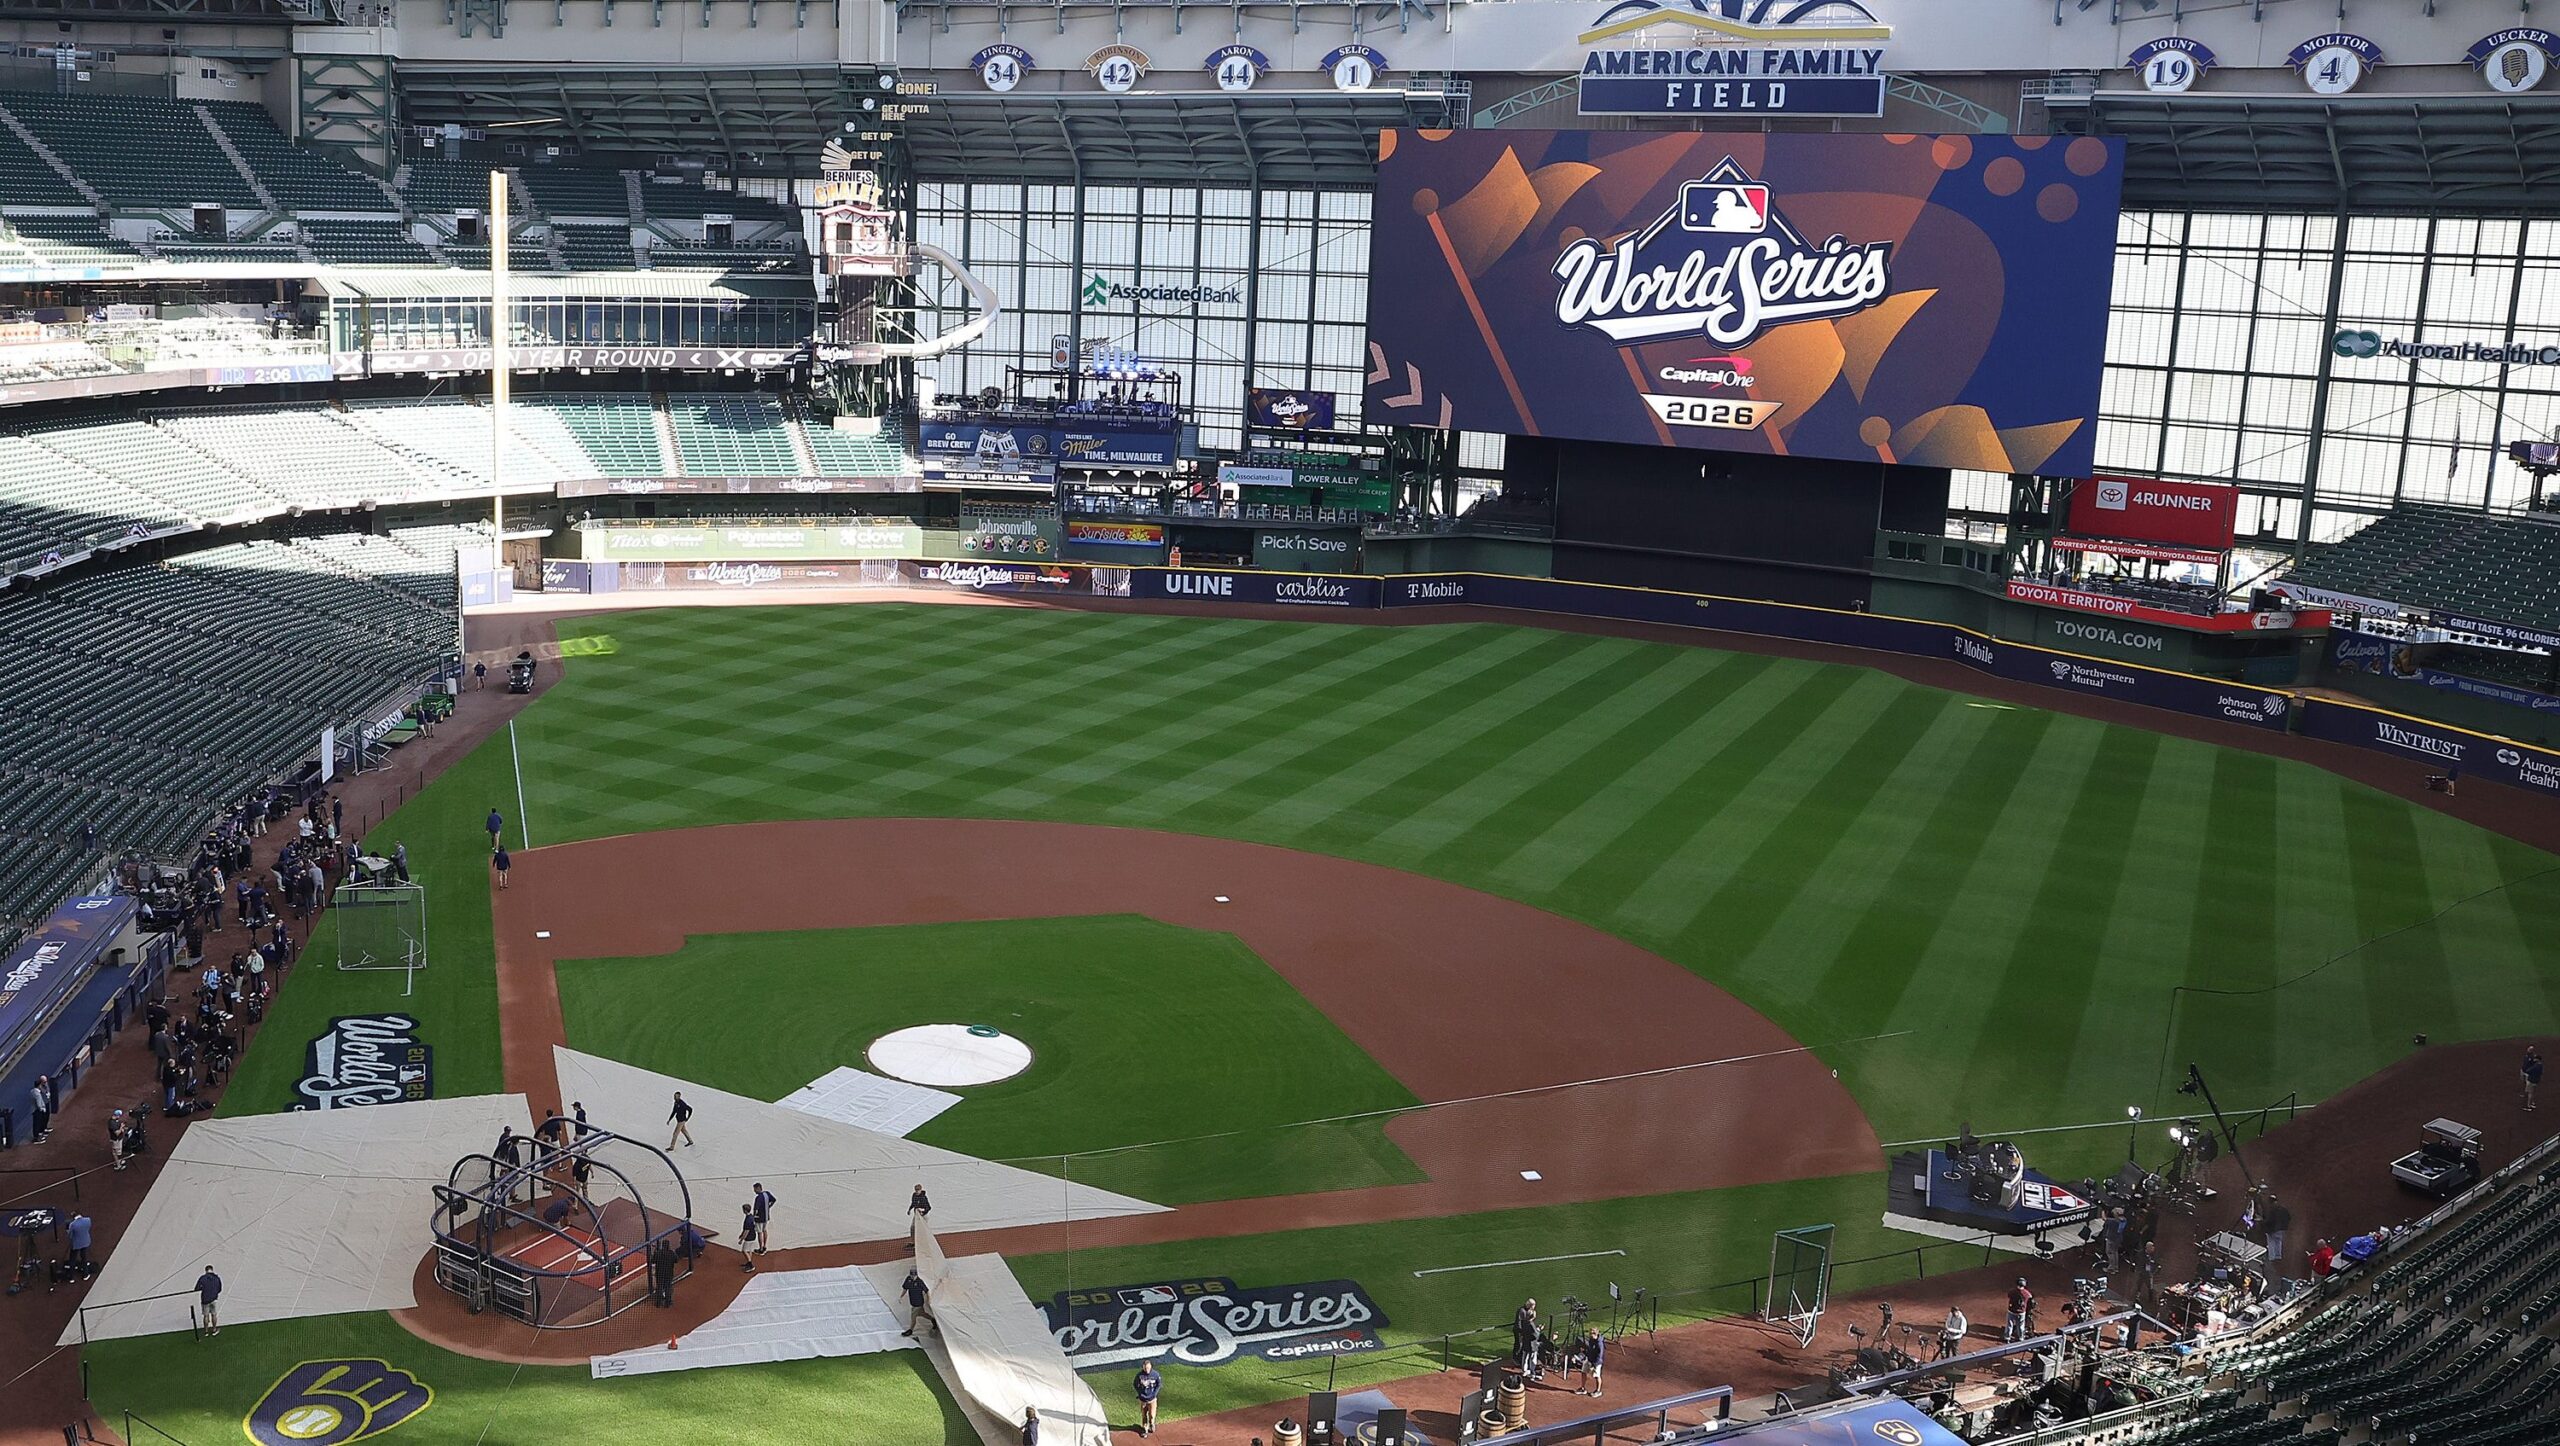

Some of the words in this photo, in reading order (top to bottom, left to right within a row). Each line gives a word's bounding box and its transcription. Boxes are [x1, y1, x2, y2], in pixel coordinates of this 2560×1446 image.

[2150, 40, 2197, 52] YOUNT
[2303, 36, 2369, 53] MOLITOR
[2488, 30, 2549, 46] UECKER
[982, 46, 1024, 59] FINGERS
[1095, 46, 1141, 61] ROBINSON
[1221, 47, 1254, 58] AARON
[1339, 46, 1370, 56] SELIG
[1582, 50, 1749, 75] AMERICAN
[1762, 49, 1885, 76] FAMILY
[2318, 58, 2342, 84] 4
[988, 62, 1016, 84] 34
[1103, 64, 1132, 84] 42
[1222, 64, 1251, 85] 44
[1348, 65, 1360, 86] 1
[2152, 60, 2190, 86] 19
[896, 84, 938, 95] GONE!
[1666, 83, 1786, 109] FIELD
[882, 105, 899, 113] GET
[900, 105, 930, 113] OUTTA
[882, 113, 906, 121] HERE
[861, 132, 878, 141] GET
[880, 132, 893, 141] UP
[851, 152, 868, 160] GET
[870, 152, 883, 160] UP
[826, 171, 873, 183] BERNIE'S
[815, 182, 884, 207] CHALET
[1556, 240, 1742, 325] World
[1706, 238, 1887, 344] Series
[462, 350, 519, 368] OPN
[528, 350, 582, 367] YEAR
[595, 350, 677, 367] ROUND
[717, 350, 745, 369] X
[750, 352, 810, 366] GOLF
[2386, 338, 2450, 361] Aurora
[2462, 341, 2532, 365] Health
[1666, 402, 1755, 426] 2026
[927, 440, 949, 448] BREW
[945, 432, 956, 441] GO
[1060, 439, 1108, 458] Miller
[1084, 451, 1109, 461] TIME,
[1110, 452, 1163, 463] MILWAUKEE
[945, 472, 965, 480] GREAT
[1299, 475, 1330, 484] POWER
[1332, 476, 1360, 485] ALLEY
[2132, 492, 2212, 511] 4RUNNER
[857, 529, 905, 543] clover
[975, 518, 1038, 536] Johnsonville
[1078, 526, 1126, 541] Surfside
[1309, 538, 1347, 552] Save
[2053, 540, 2088, 550] COURTESY
[2098, 545, 2117, 553] YOUR
[2118, 547, 2158, 557] WISCONSIN
[2158, 551, 2186, 559] TOYOTA
[2186, 554, 2218, 563] DEALERS
[1166, 574, 1233, 596] ULINE
[1276, 577, 1351, 597] carbliss
[1421, 582, 1464, 598] Mobile
[2010, 584, 2058, 602] TOYOTA
[2061, 593, 2133, 614] TERRITORY
[2056, 620, 2163, 651] TOYOTA.COM
[2450, 618, 2477, 630] GREAT
[2478, 622, 2505, 636] TASTE.
[2506, 628, 2518, 639] 96
[1963, 639, 1994, 664] Mobile
[2336, 640, 2386, 659] Culver's
[2071, 674, 2104, 688] Mutual
[2072, 665, 2135, 685] Northwestern
[2218, 696, 2257, 710] Johnson
[2224, 706, 2264, 722] Controls
[2378, 722, 2463, 758] WINTRUST
[2522, 757, 2560, 777] Aurora
[2520, 769, 2560, 790] Health
[338, 1016, 413, 1085] World
[2043, 1212, 2090, 1228] NETWORK
[1183, 1281, 1226, 1295] 26
[1066, 1293, 1111, 1307] 20
[1172, 1291, 1372, 1363] Series
[1266, 1341, 1337, 1358] Capital
[1338, 1339, 1374, 1351] One
